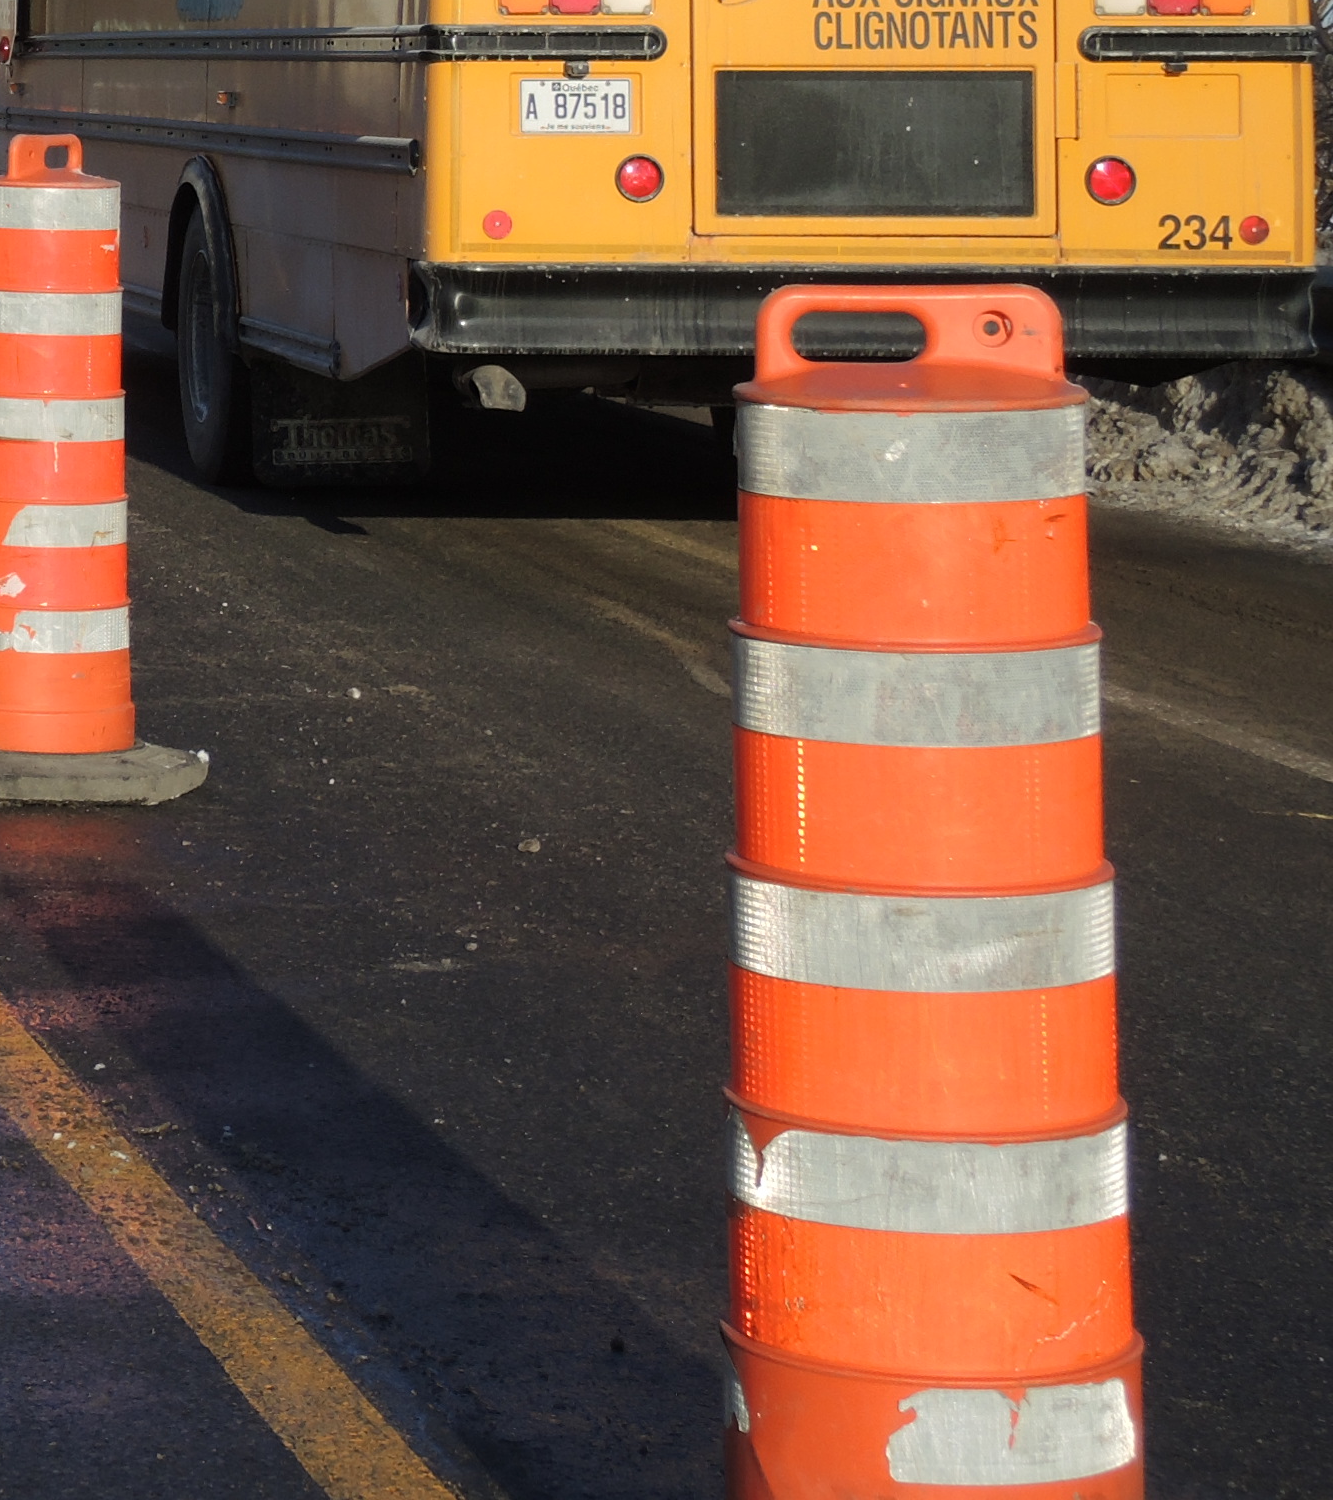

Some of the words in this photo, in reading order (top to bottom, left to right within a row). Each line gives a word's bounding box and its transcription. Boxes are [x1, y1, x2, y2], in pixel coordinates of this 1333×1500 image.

[813, 11, 1038, 50] CLIGNOTANTS
[562, 83, 599, 92] Québec
[525, 93, 538, 120] A
[554, 93, 626, 120] 87518
[1158, 214, 1233, 250] 234
